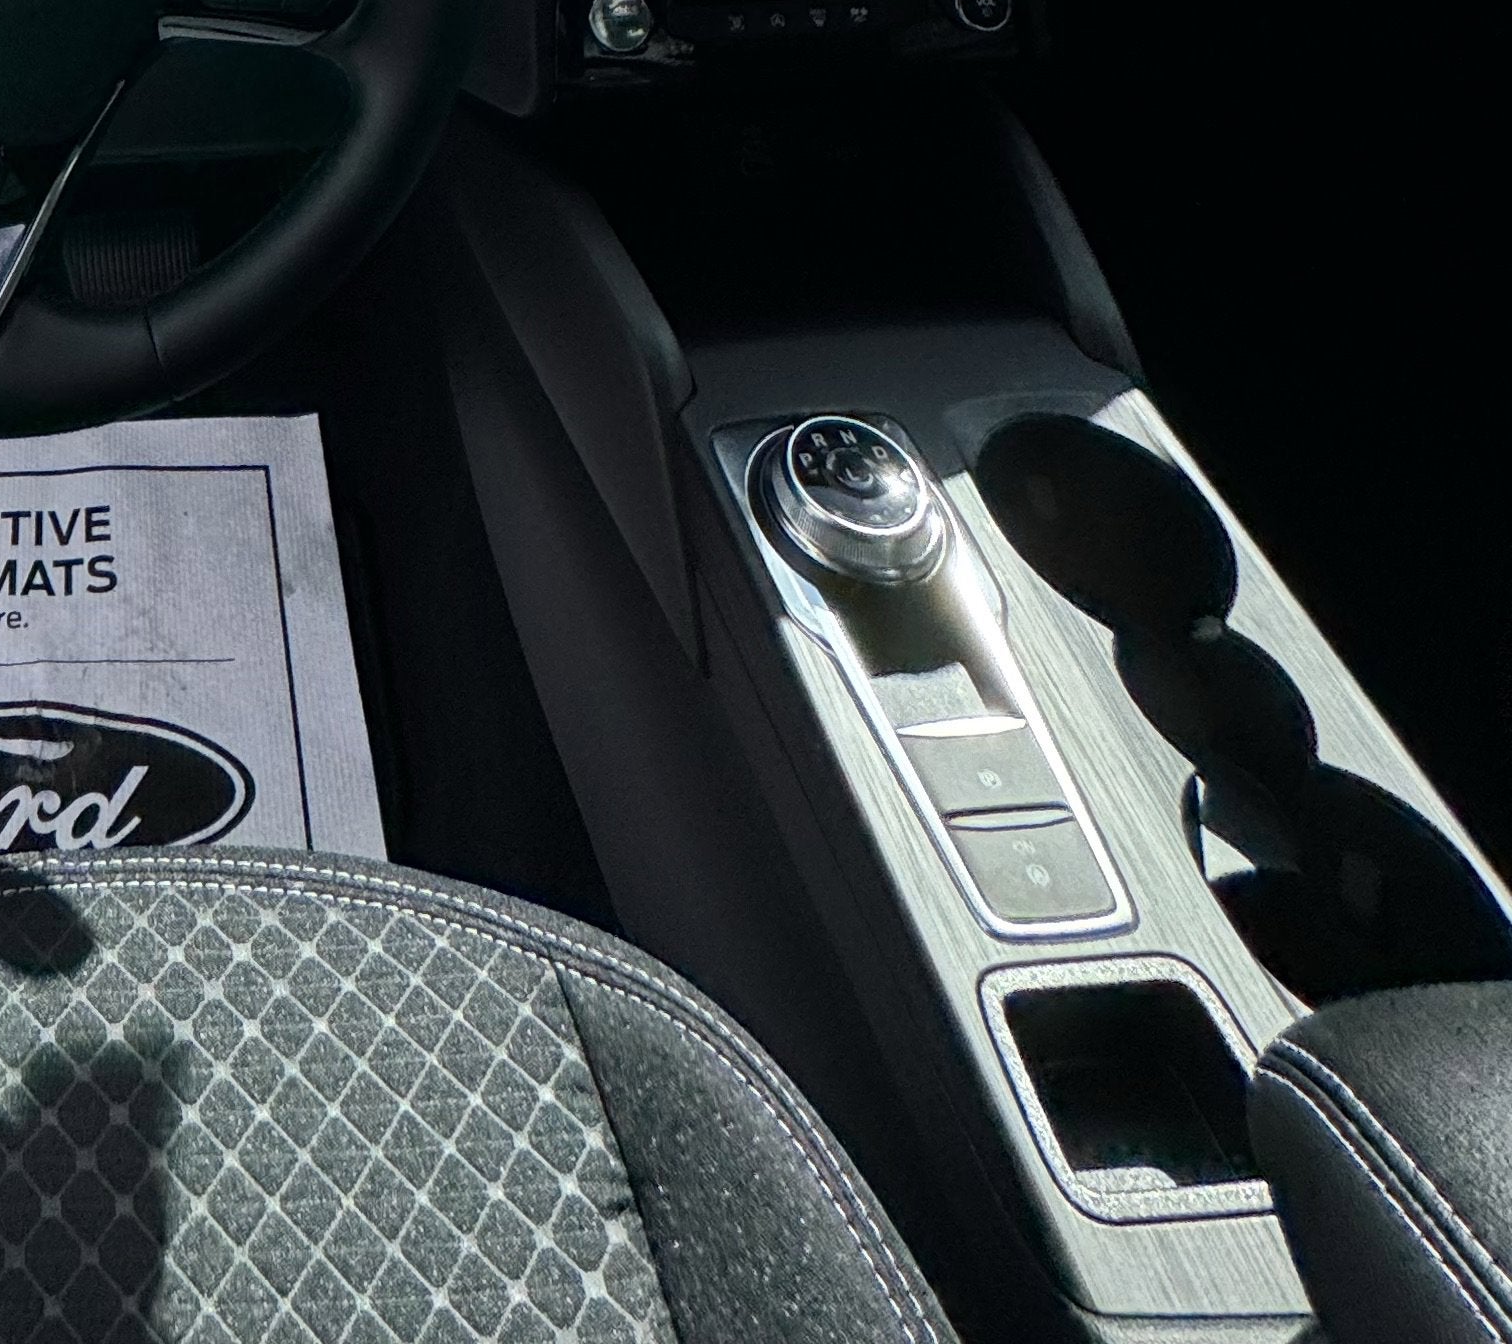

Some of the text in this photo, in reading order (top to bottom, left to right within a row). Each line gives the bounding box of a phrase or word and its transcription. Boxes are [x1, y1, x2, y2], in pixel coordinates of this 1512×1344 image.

[799, 429, 890, 467] P R N D
